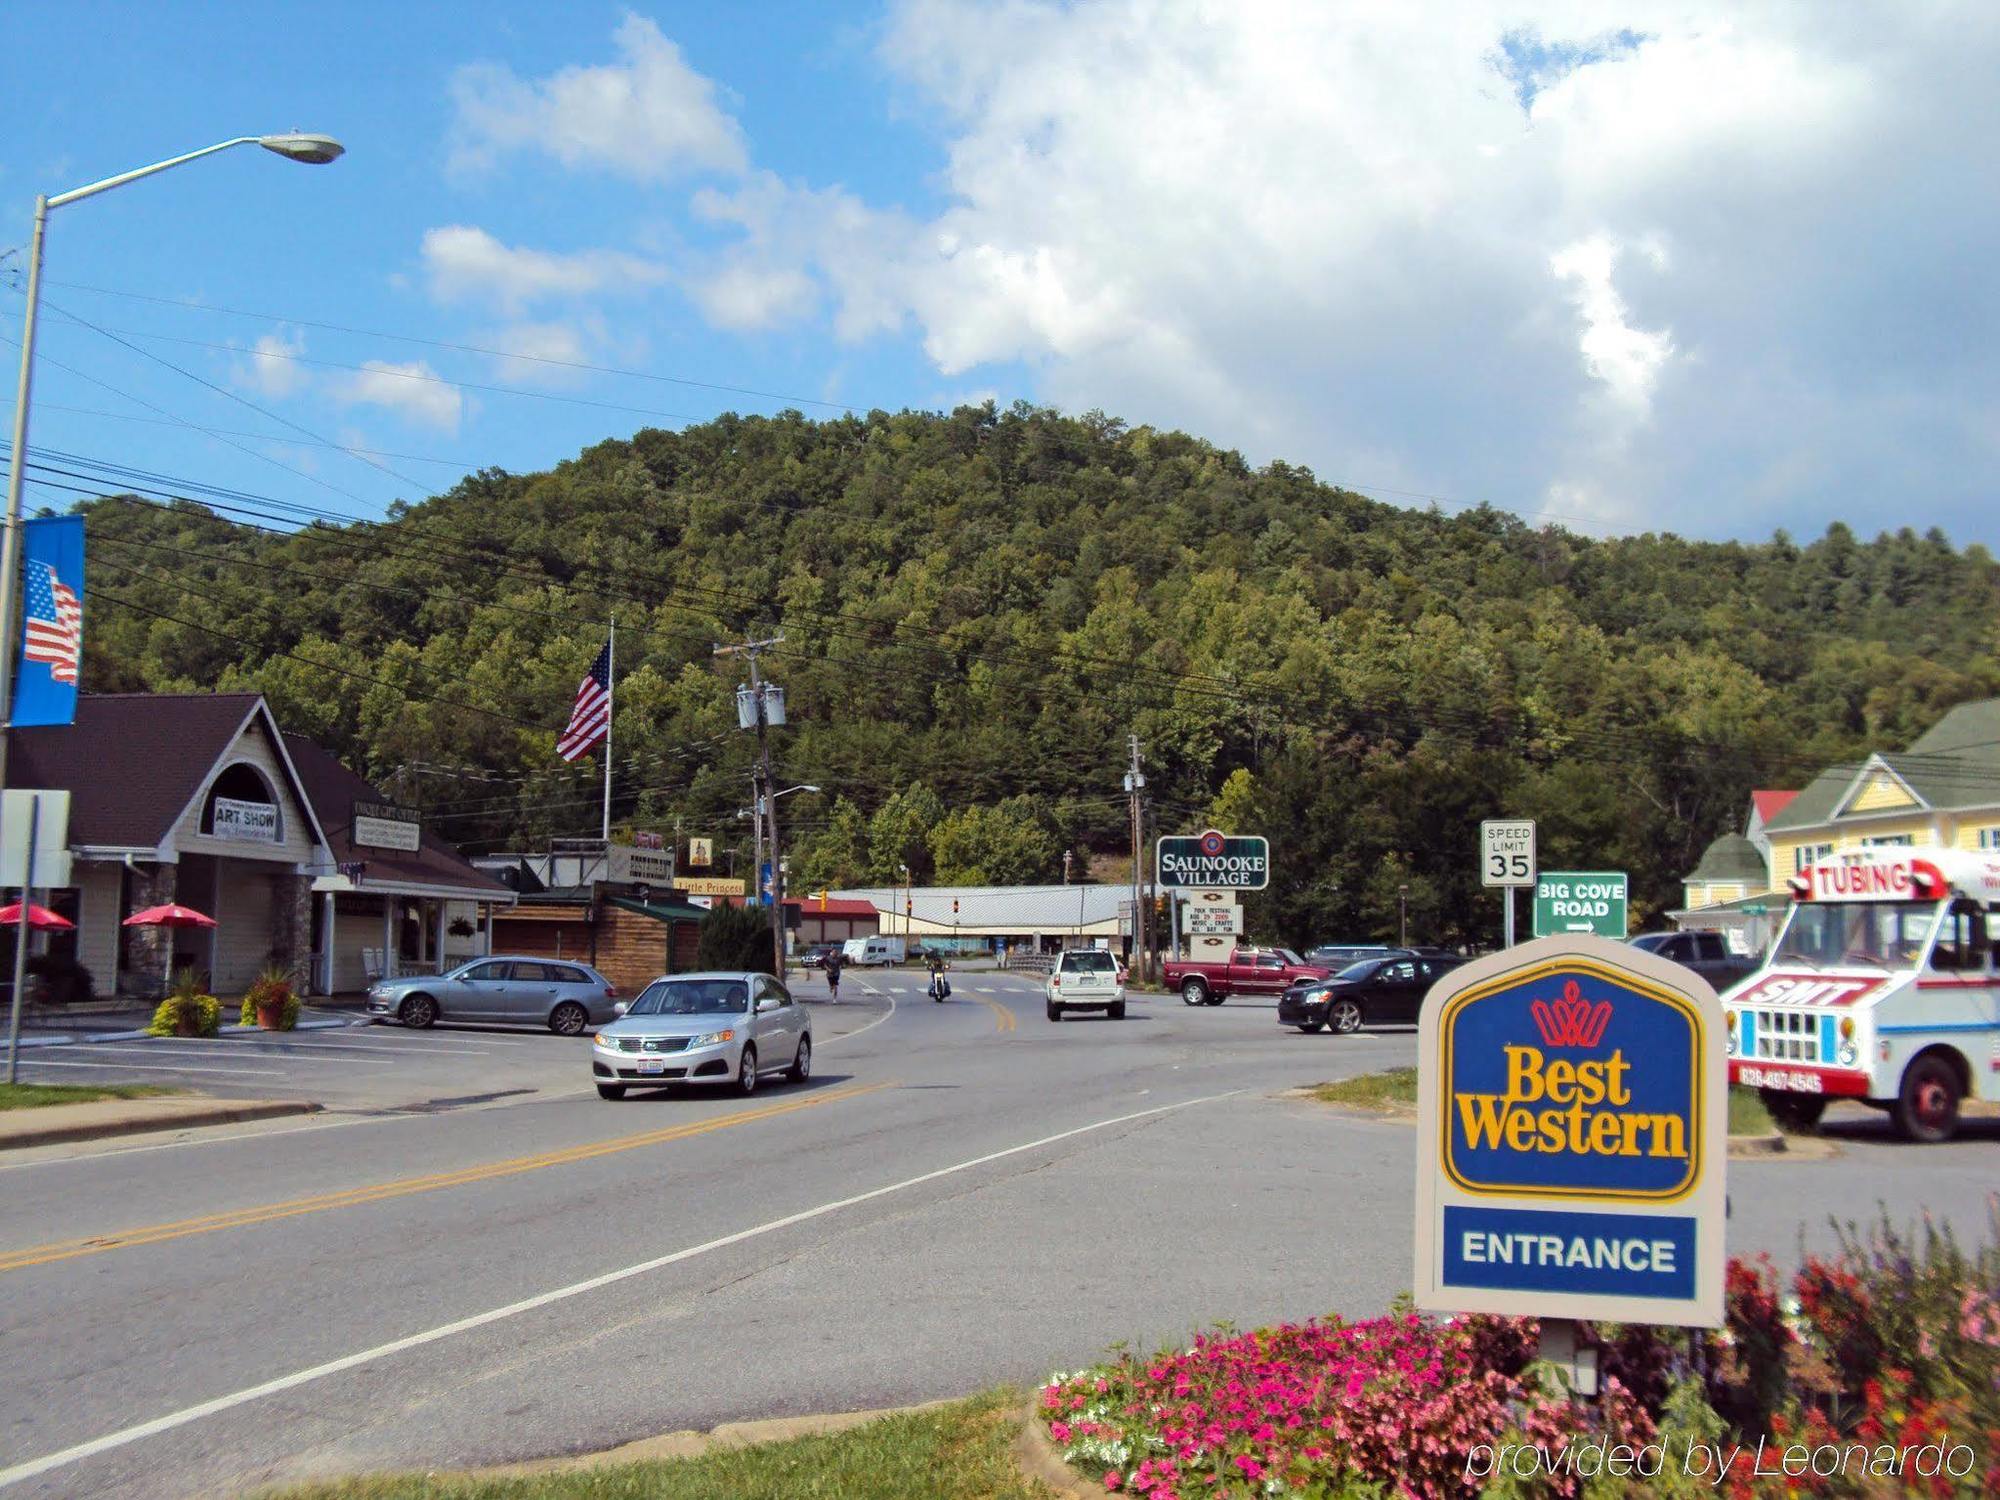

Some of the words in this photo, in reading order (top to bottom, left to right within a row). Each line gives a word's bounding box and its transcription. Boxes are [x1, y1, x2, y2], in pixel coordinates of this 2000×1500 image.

[216, 808, 240, 824] ART
[244, 811, 275, 828] SHOW
[1488, 829, 1530, 839] SPEED
[1493, 842, 1525, 852] LIMIT
[1162, 854, 1265, 872] SAUNOOKE
[1490, 855, 1529, 877] 35
[680, 882, 703, 893] Little
[706, 882, 743, 893] Princess
[1176, 872, 1250, 885] VILLAGE
[1818, 864, 1908, 894] TUBING
[1538, 884, 1570, 899] BIG
[1575, 884, 1625, 899] COVE
[1553, 901, 1609, 917] ROAD
[1750, 979, 1867, 1006] SMT
[1503, 1045, 1631, 1106] Best
[1454, 1092, 1689, 1158] Western
[1462, 1231, 1676, 1273] ENTRANCE
